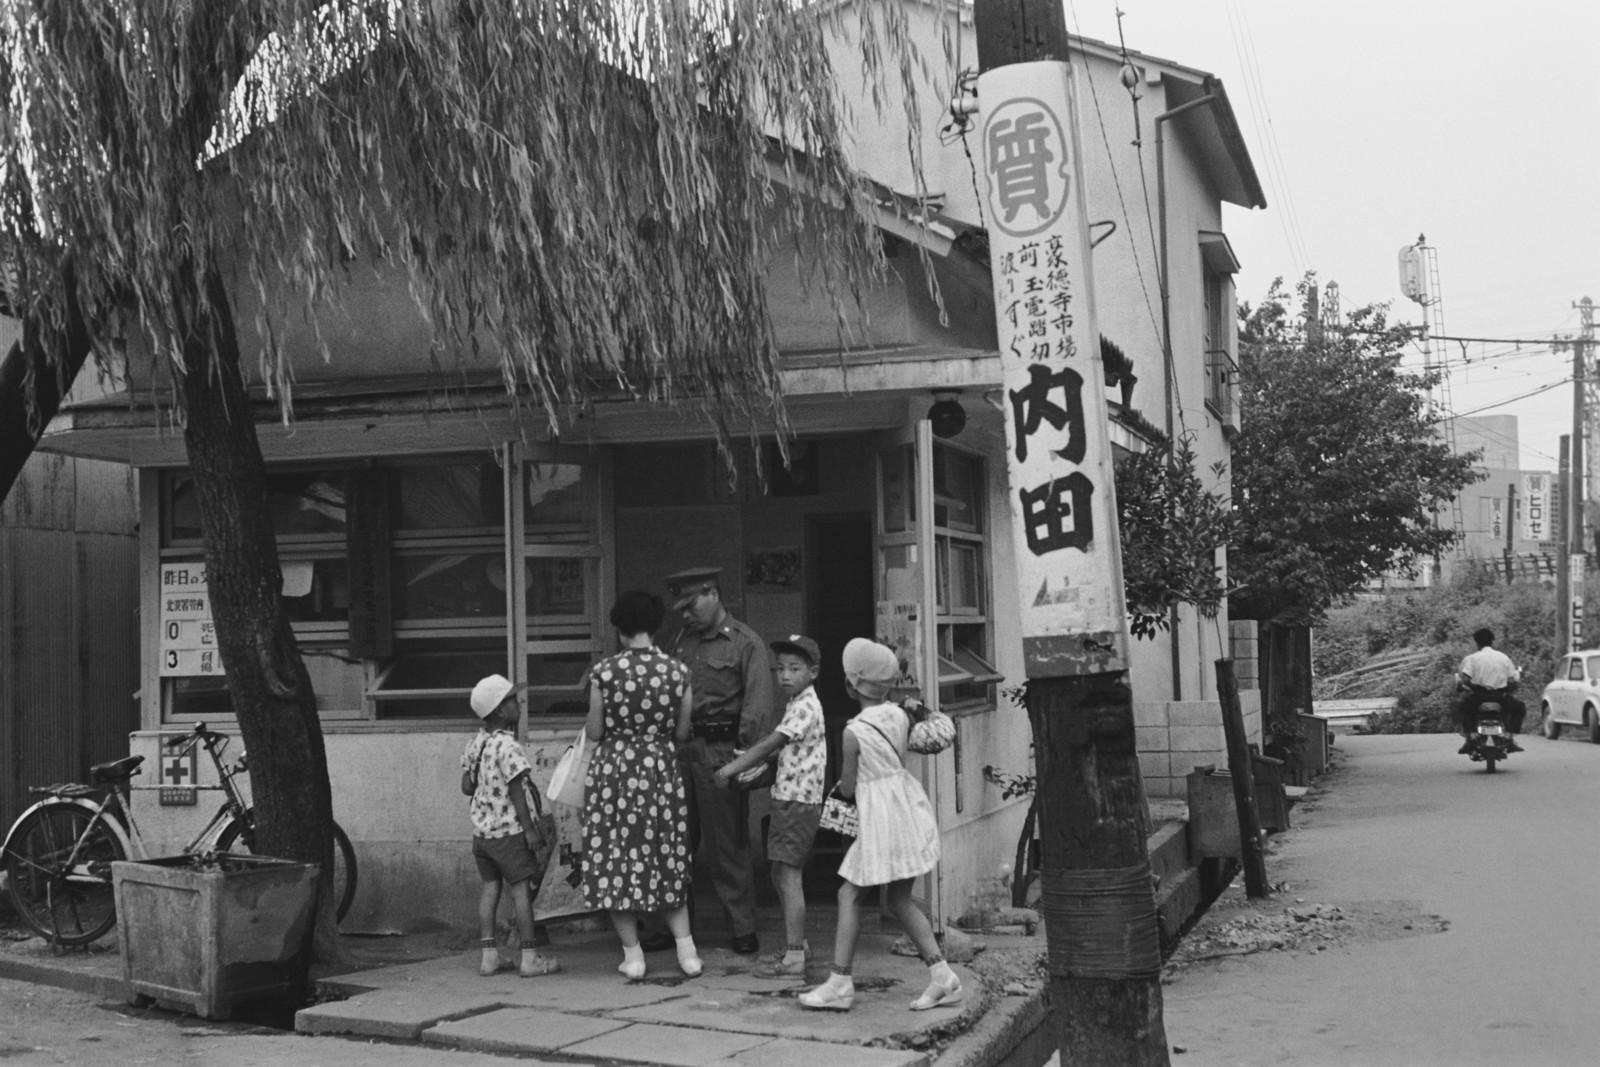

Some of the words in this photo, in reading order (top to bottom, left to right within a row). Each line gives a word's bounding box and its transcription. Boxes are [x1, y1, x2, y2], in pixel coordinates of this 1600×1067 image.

[1009, 363, 1094, 556] 内田
[1529, 494, 1542, 533] ヒロセ
[168, 622, 179, 640] 0
[167, 650, 178, 669] 3
